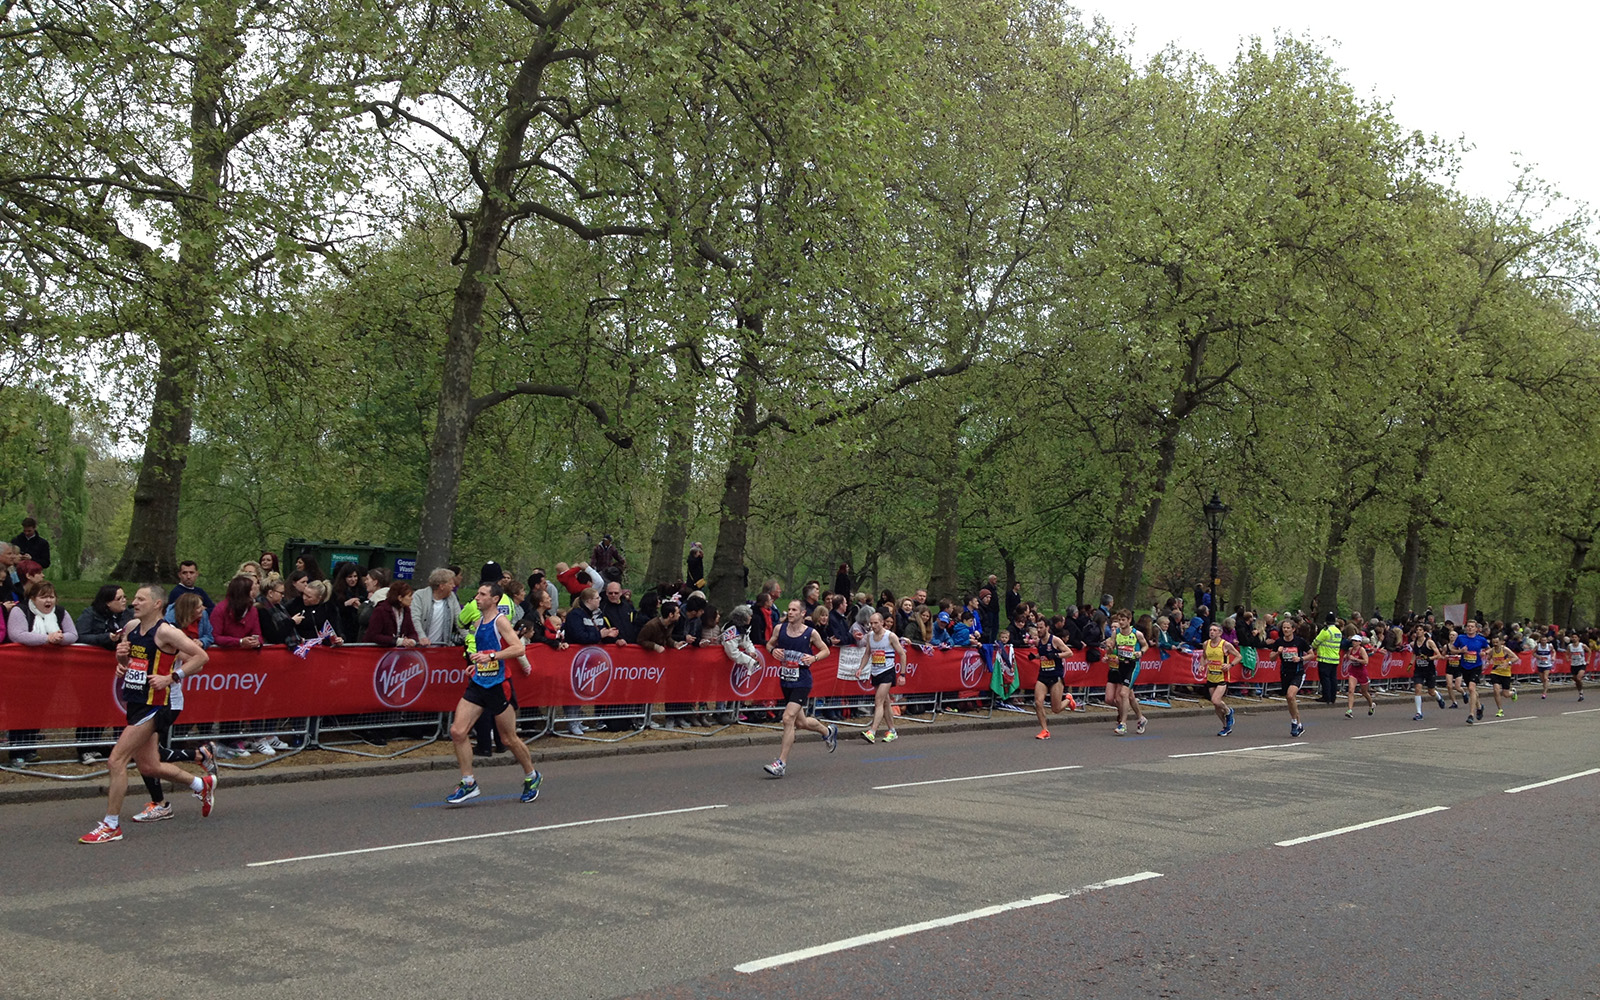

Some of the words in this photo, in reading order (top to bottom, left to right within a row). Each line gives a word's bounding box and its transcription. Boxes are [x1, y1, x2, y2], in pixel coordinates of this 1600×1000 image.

[379, 655, 424, 698] Virgin
[430, 668, 466, 684] mon
[575, 653, 609, 692] Virgin
[613, 666, 666, 683] money
[734, 662, 762, 689] Vir
[894, 662, 918, 677] oey
[963, 650, 983, 682] Virgin
[1066, 660, 1091, 673] money
[1140, 660, 1162, 672] money
[1258, 660, 1278, 671] money
[187, 673, 267, 695] money
